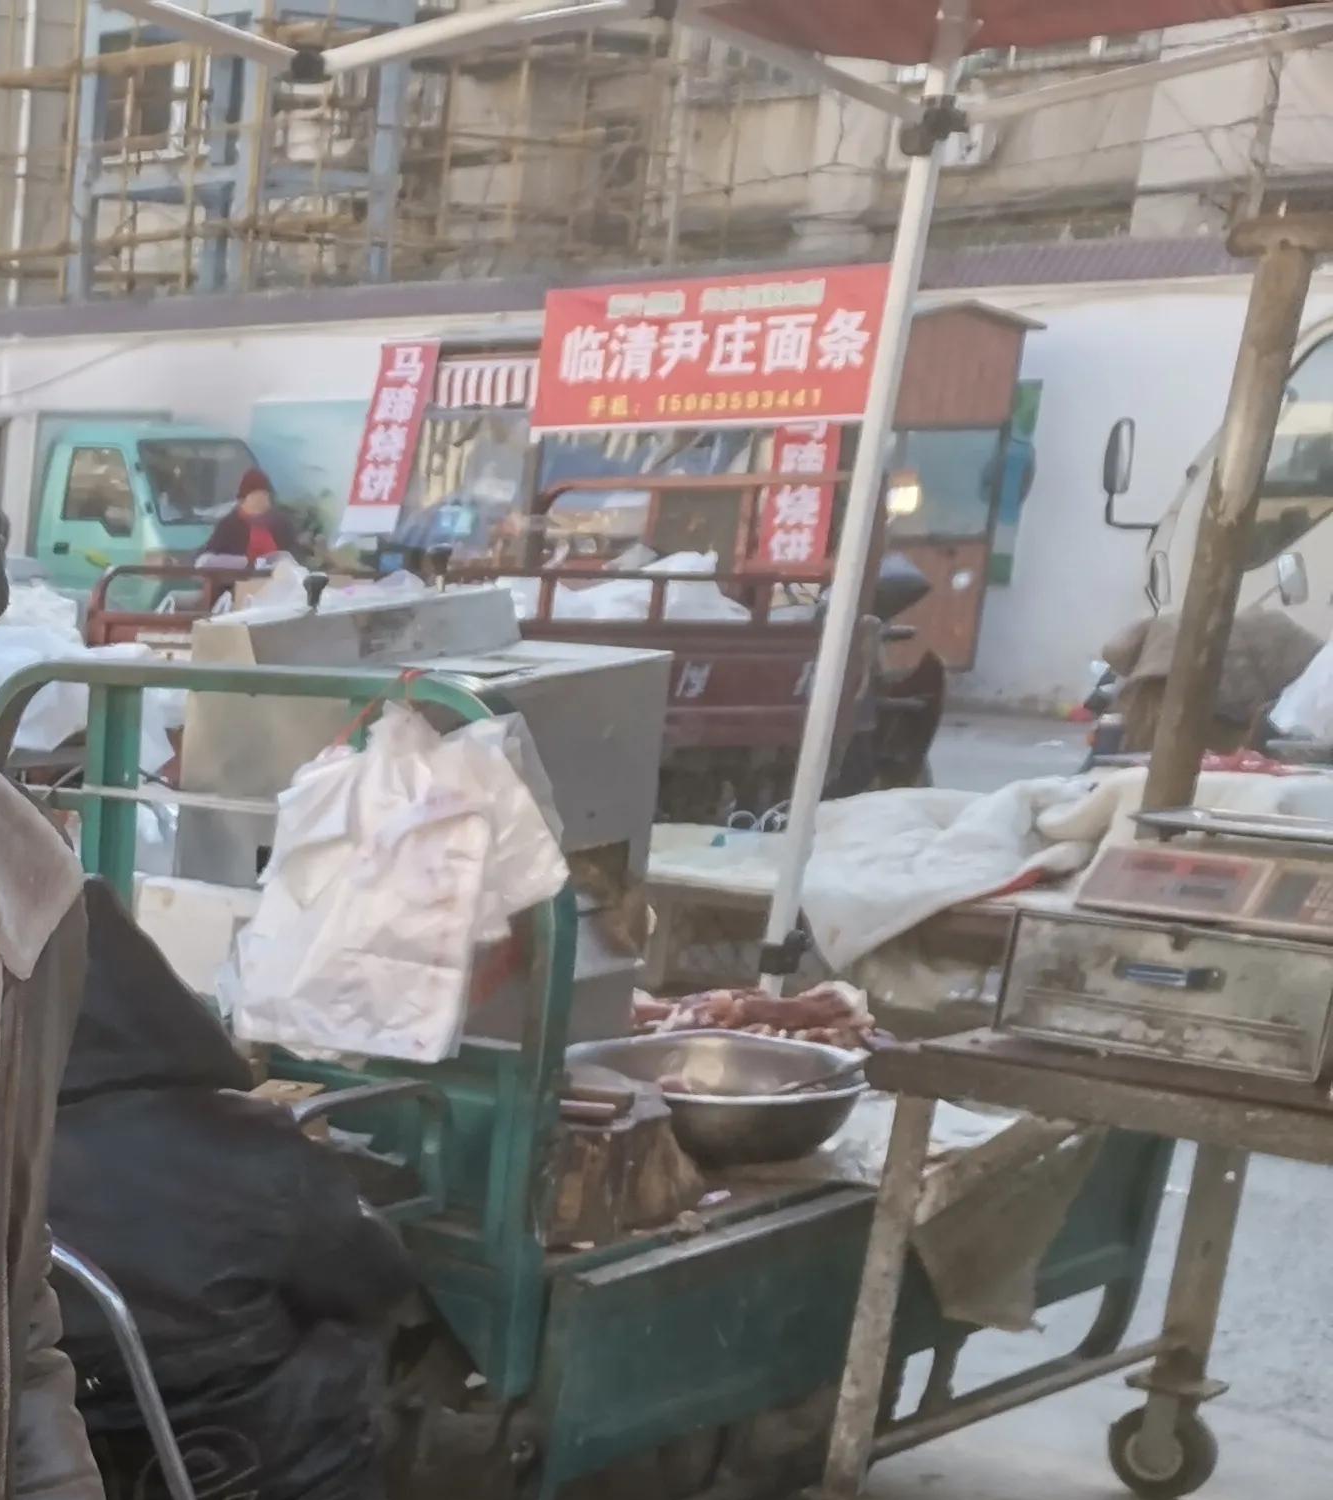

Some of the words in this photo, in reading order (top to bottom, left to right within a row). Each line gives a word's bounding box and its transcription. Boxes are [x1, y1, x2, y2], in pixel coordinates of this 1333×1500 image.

[559, 308, 871, 384] 临清尹庄面条
[358, 346, 425, 502] 马蹄烧饼
